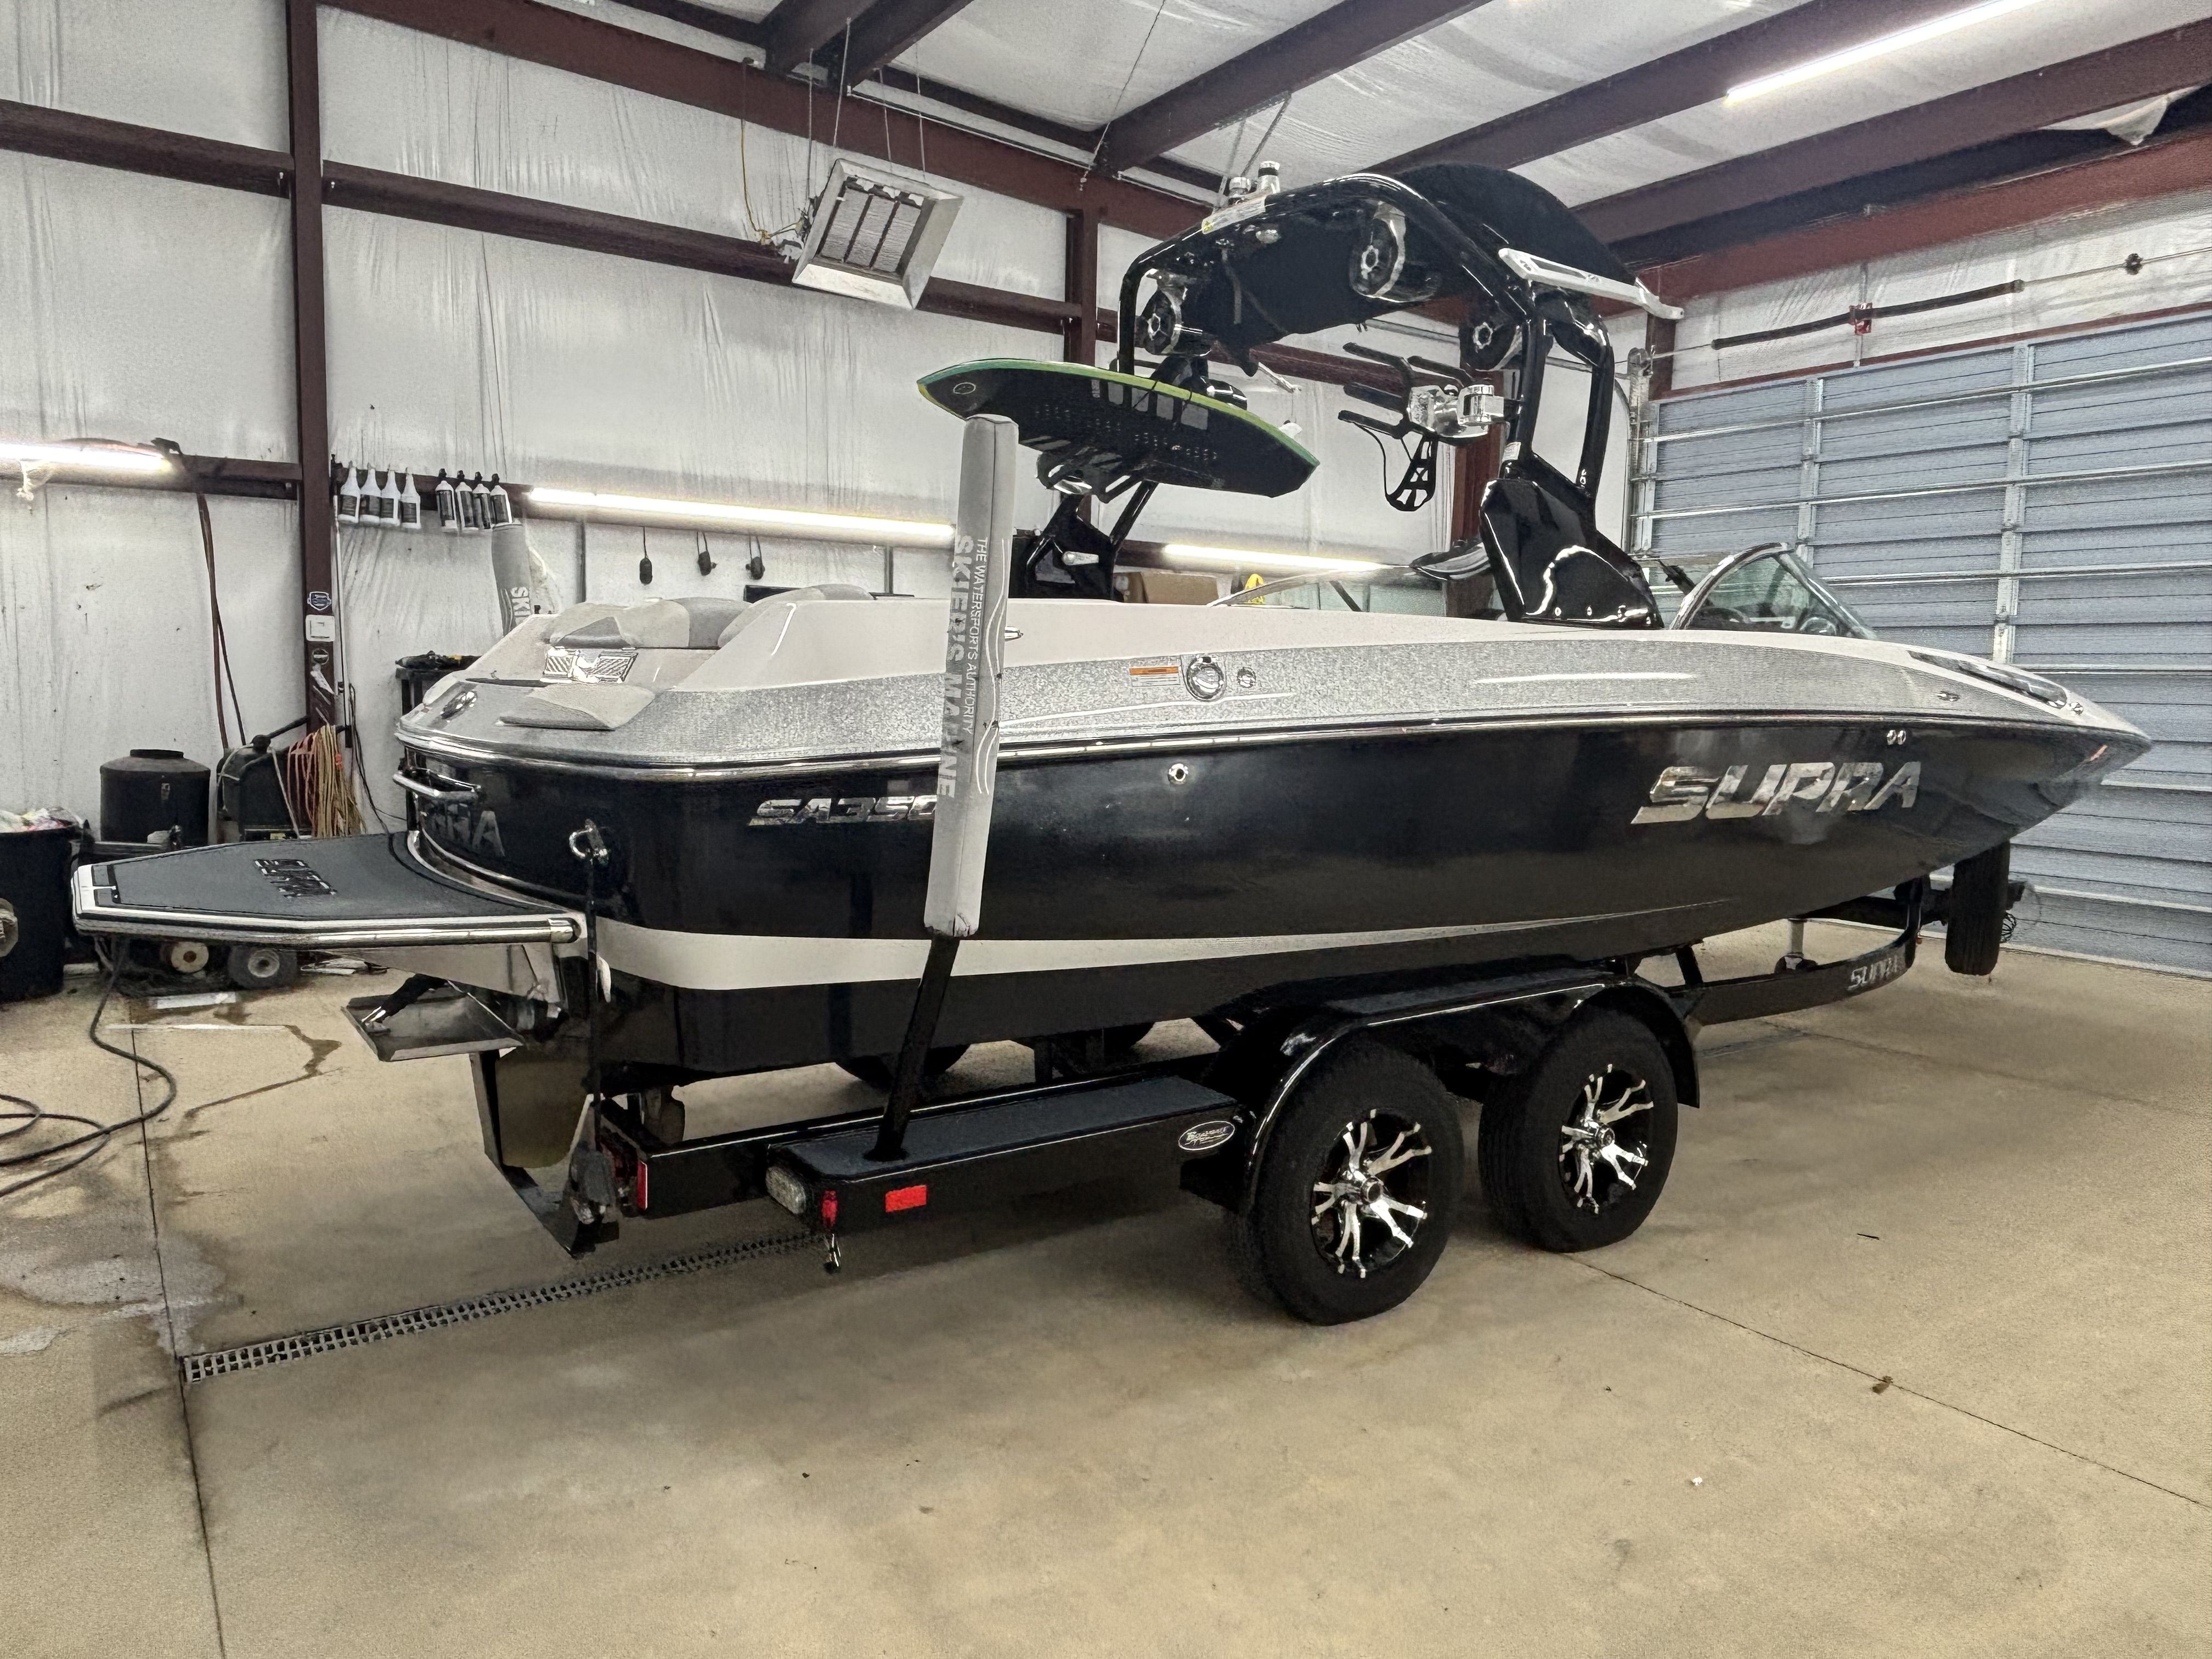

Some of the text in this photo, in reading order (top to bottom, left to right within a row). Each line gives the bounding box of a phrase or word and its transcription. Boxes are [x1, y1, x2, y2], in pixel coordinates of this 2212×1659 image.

[937, 534, 974, 798] SKIER'S MANE
[962, 537, 988, 734] THE WATERSPORTS AUTHORITY
[1630, 761, 1922, 825] SUPRA
